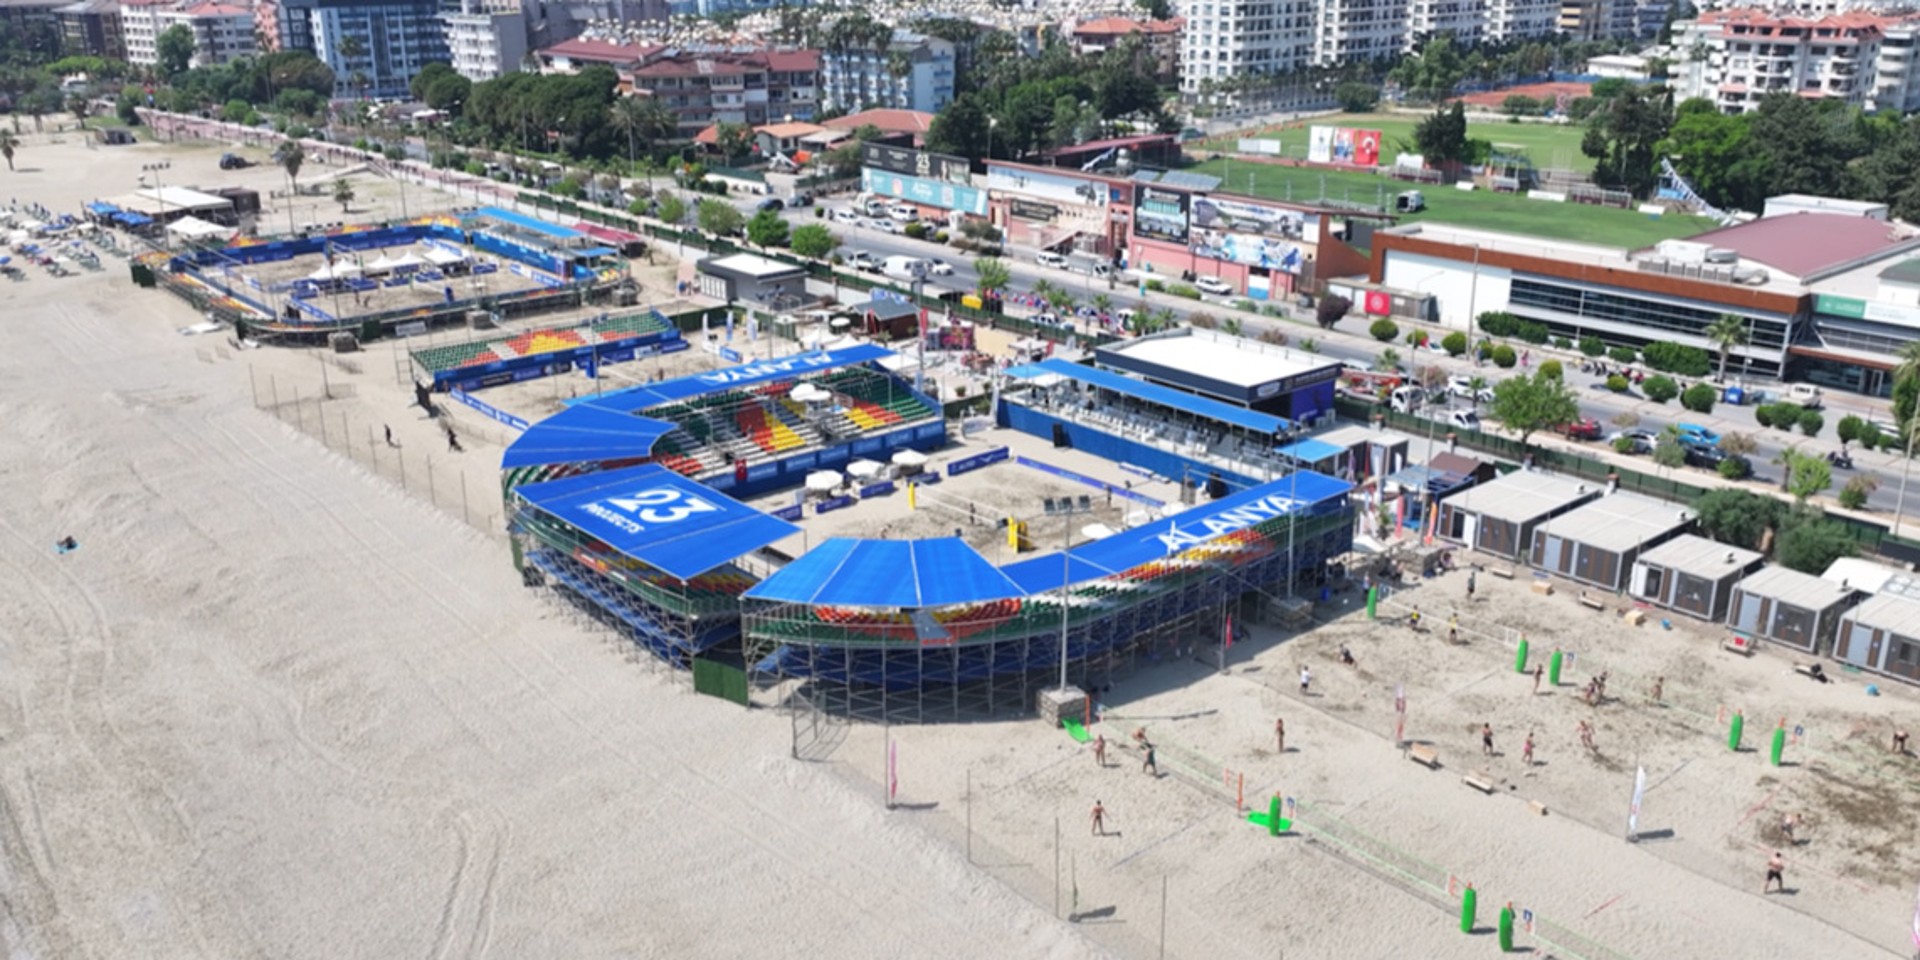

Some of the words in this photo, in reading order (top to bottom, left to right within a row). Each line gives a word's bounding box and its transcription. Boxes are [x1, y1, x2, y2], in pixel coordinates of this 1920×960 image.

[701, 352, 832, 382] ALANYA
[578, 502, 645, 534] PROJECTS
[606, 489, 717, 523] 23
[1157, 496, 1308, 551] ALANYA
